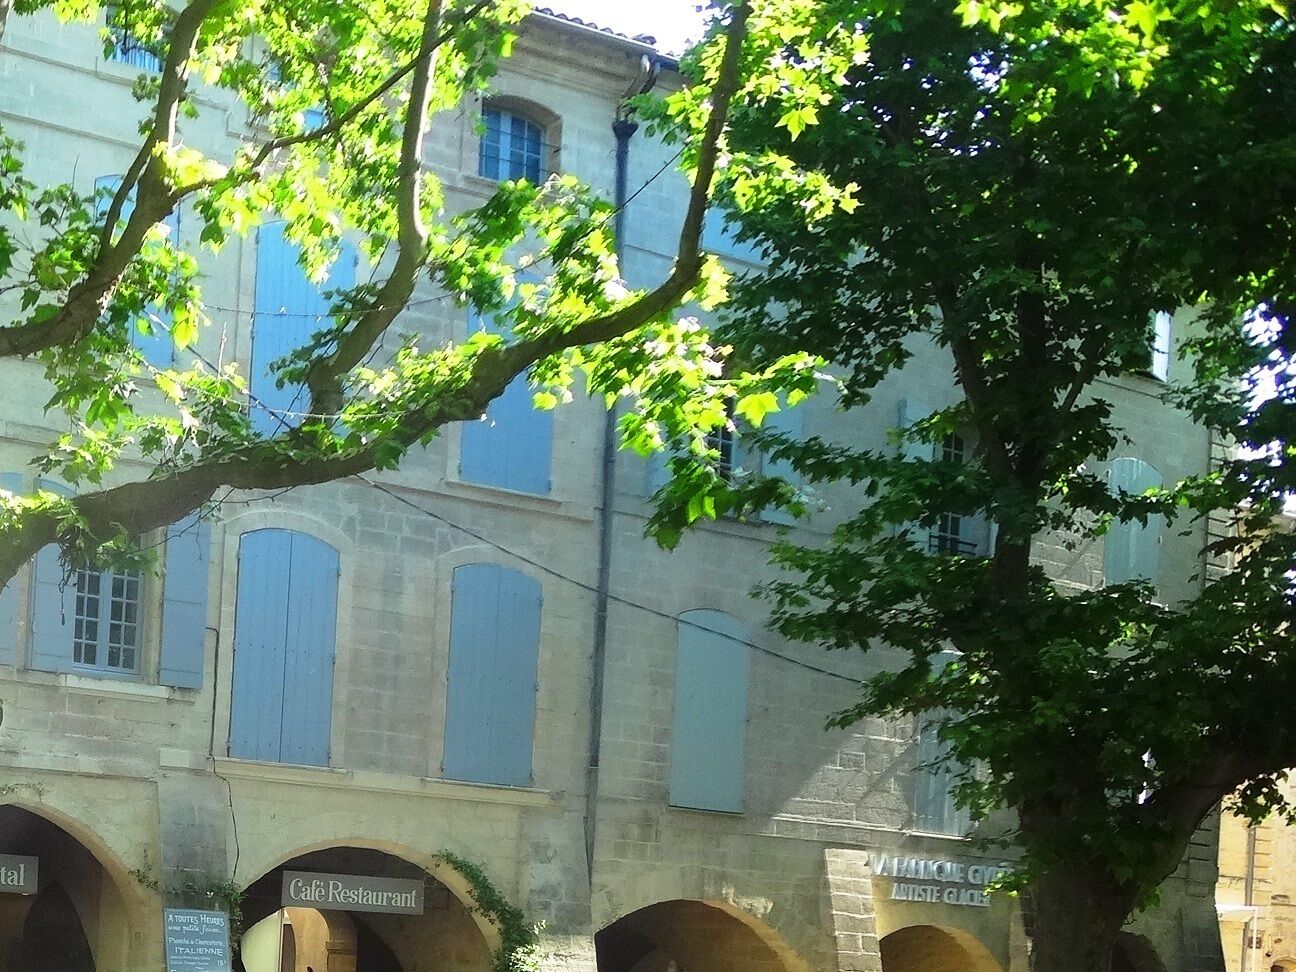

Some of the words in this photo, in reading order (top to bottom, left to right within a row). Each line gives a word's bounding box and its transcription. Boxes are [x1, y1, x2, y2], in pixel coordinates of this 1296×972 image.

[289, 878, 325, 902] Café
[327, 880, 417, 908] Restaurant
[891, 883, 941, 903] ARTISTE
[175, 915, 199, 925] TOUTES
[169, 937, 189, 945] Planche
[174, 946, 224, 957] ITALIENNE
